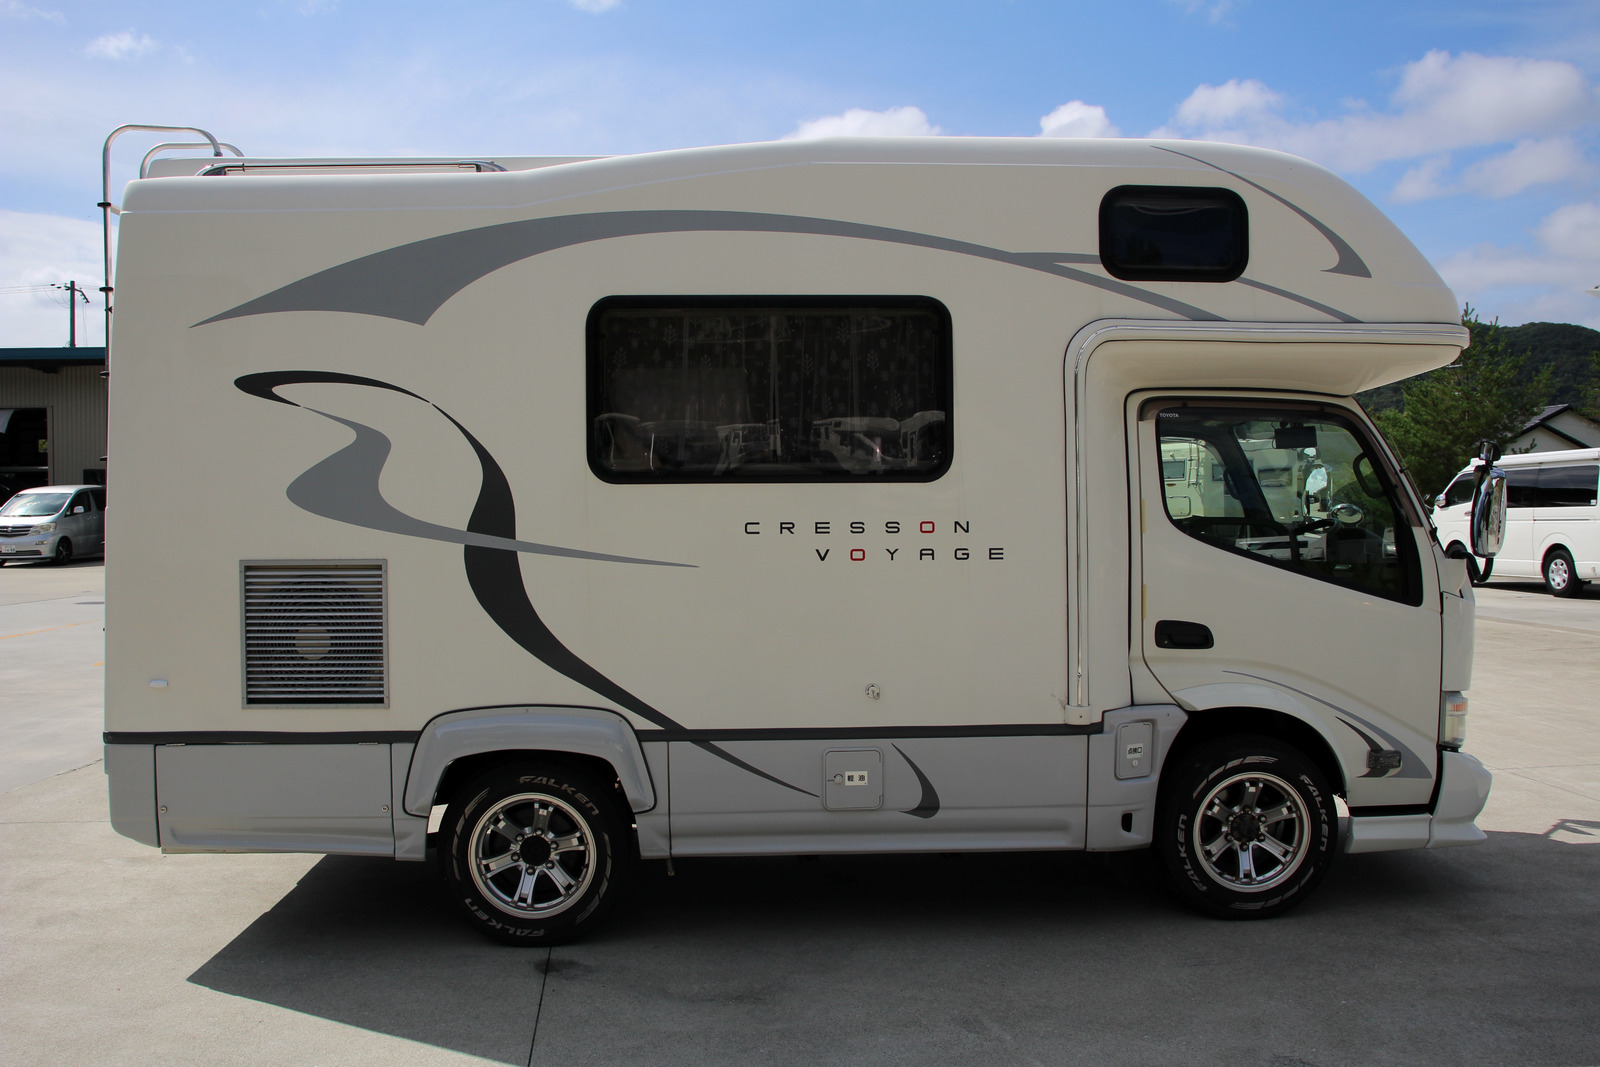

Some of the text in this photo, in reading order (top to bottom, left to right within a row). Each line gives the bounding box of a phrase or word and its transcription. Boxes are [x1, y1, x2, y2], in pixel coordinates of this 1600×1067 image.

[744, 520, 970, 535] CRESSON
[815, 547, 1004, 562] VOYAGE
[847, 774, 866, 782] 軽油
